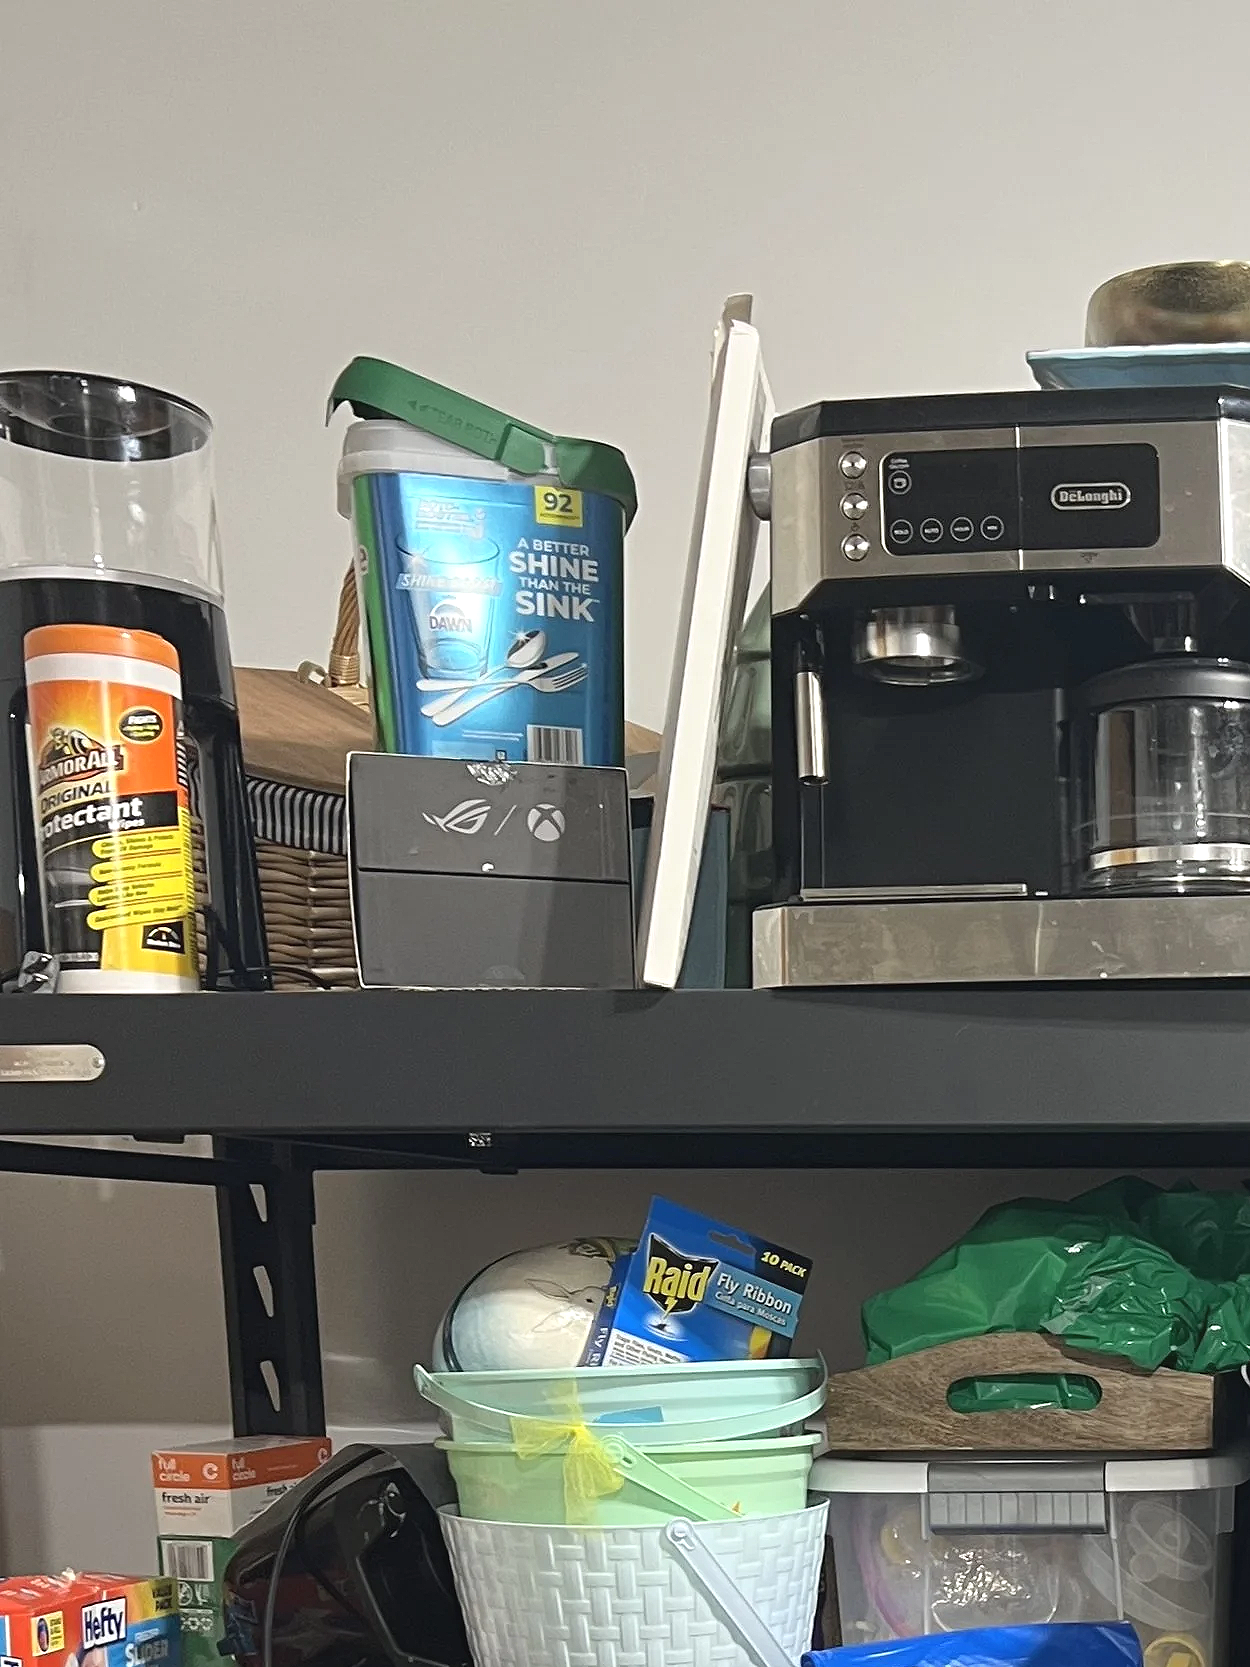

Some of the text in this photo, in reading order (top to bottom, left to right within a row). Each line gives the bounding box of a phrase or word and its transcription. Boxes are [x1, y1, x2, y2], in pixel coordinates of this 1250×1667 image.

[543, 492, 573, 513] 92
[517, 537, 590, 557] A BETTER
[509, 551, 599, 582] SHINE
[519, 577, 591, 596] THAN THE
[515, 591, 600, 622] SINK
[429, 616, 472, 632] DAWN
[762, 1250, 806, 1278] 10 PACK
[643, 1257, 712, 1302] Raid
[717, 1273, 792, 1315] Fly Ribbon
[162, 1492, 211, 1504] fresh air
[85, 1606, 124, 1642] Hefty
